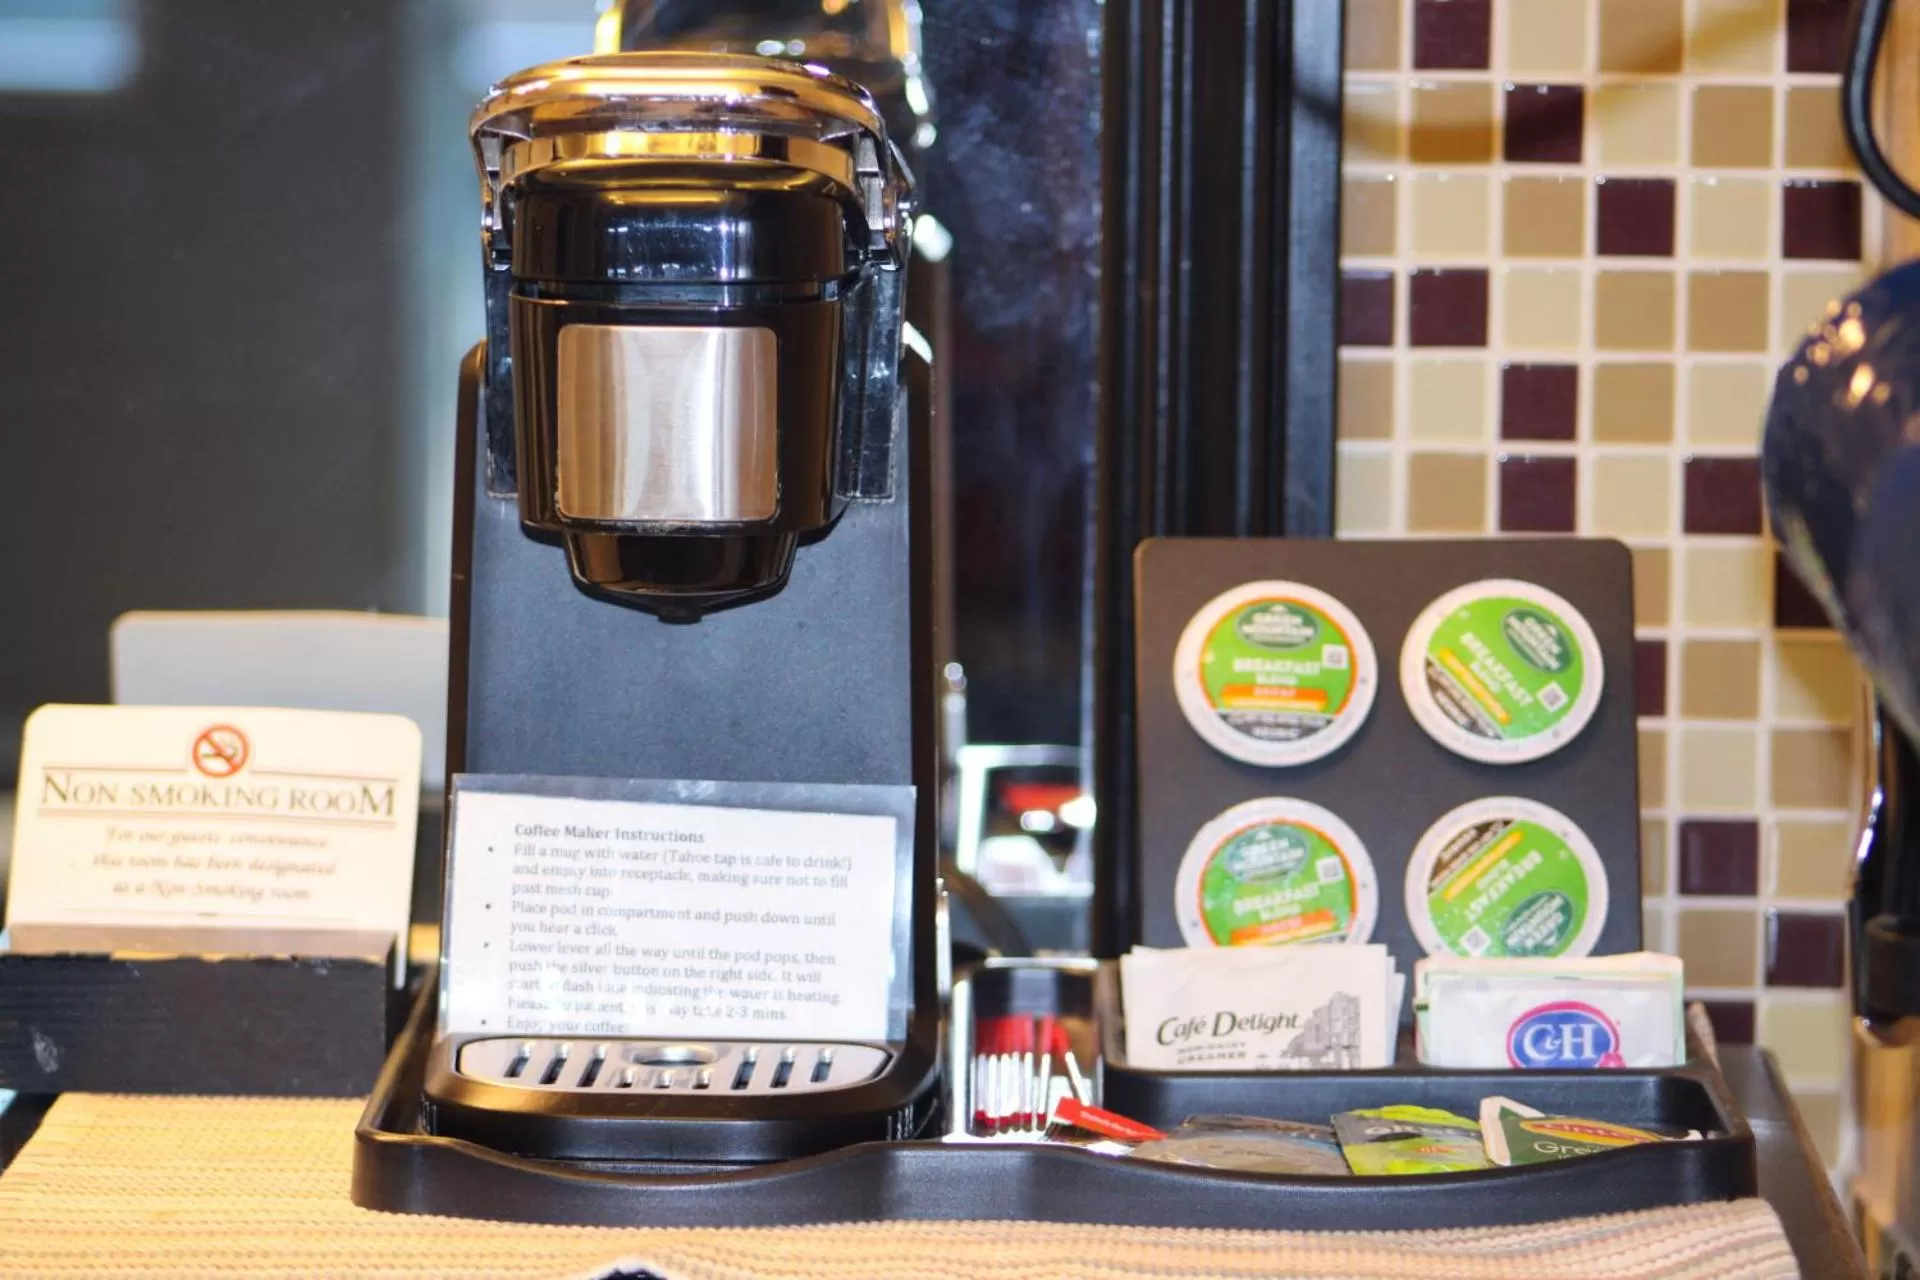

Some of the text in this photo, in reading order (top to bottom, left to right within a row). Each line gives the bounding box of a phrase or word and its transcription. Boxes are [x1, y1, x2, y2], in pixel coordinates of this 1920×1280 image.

[42, 771, 396, 817] NON SMOKING ROOM
[513, 823, 706, 844] Coffee Maker Instructions
[513, 843, 537, 856] Fill
[539, 848, 548, 857] a
[550, 848, 581, 862] mug
[584, 846, 614, 859] with
[618, 849, 659, 862] water
[662, 848, 711, 865] (Tahoe
[714, 853, 738, 868] tap
[740, 854, 753, 866] is
[786, 856, 801, 869] to
[512, 862, 539, 876] and
[589, 866, 617, 878] into
[621, 868, 694, 884] receptacle,
[697, 871, 749, 887] making
[752, 874, 782, 886] sure
[786, 874, 810, 887] not
[812, 875, 828, 888] to
[831, 874, 848, 889] fill
[512, 882, 541, 896] past
[545, 882, 582, 896] mesh
[512, 900, 837, 927] Place pod in compartment and push down until
[509, 922, 536, 936] you
[539, 921, 569, 934] hear
[573, 925, 582, 934] a
[509, 939, 554, 954] Lower
[557, 941, 591, 955] lever
[594, 942, 614, 956] all
[615, 943, 638, 957] the
[641, 947, 670, 961] way
[672, 945, 706, 960] until
[708, 947, 732, 961] the
[734, 949, 762, 964] pod
[804, 951, 837, 966] then
[509, 959, 542, 974] push
[571, 961, 609, 976] silver
[613, 962, 659, 977] button
[662, 967, 681, 978] on
[684, 964, 706, 979] the
[709, 965, 743, 982] right
[781, 969, 792, 982] It
[796, 969, 822, 984] will
[508, 978, 541, 992] sart
[562, 978, 594, 993] flash
[631, 982, 701, 1000] indicating
[729, 988, 769, 1002] water
[772, 987, 785, 1001] is
[574, 999, 624, 1017] paient
[726, 1004, 749, 1019] 2-3
[548, 1020, 582, 1034] your
[1157, 1010, 1299, 1046] Café Delight
[1522, 1023, 1597, 1061] C&H
